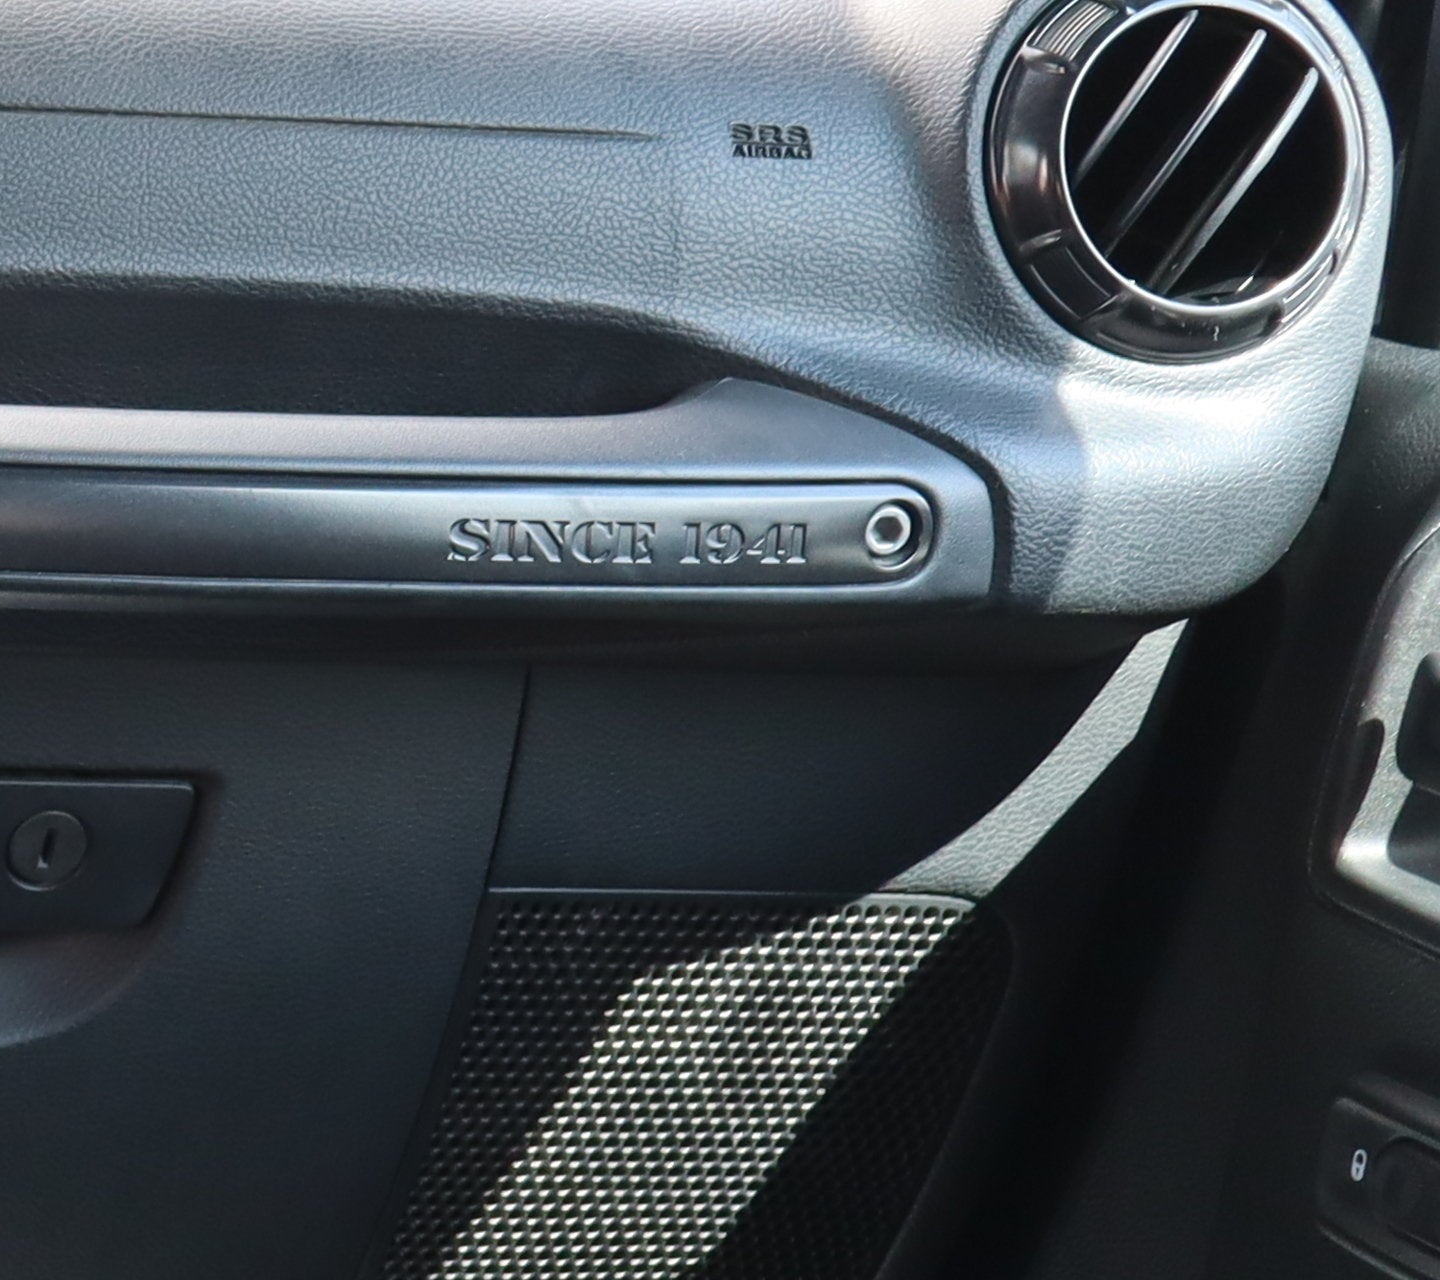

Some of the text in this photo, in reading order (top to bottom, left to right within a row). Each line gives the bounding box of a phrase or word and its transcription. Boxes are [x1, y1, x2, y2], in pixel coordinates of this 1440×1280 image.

[729, 120, 811, 146] SRS
[731, 143, 813, 161] AIRBAG
[447, 517, 809, 566] SINCE 1941
